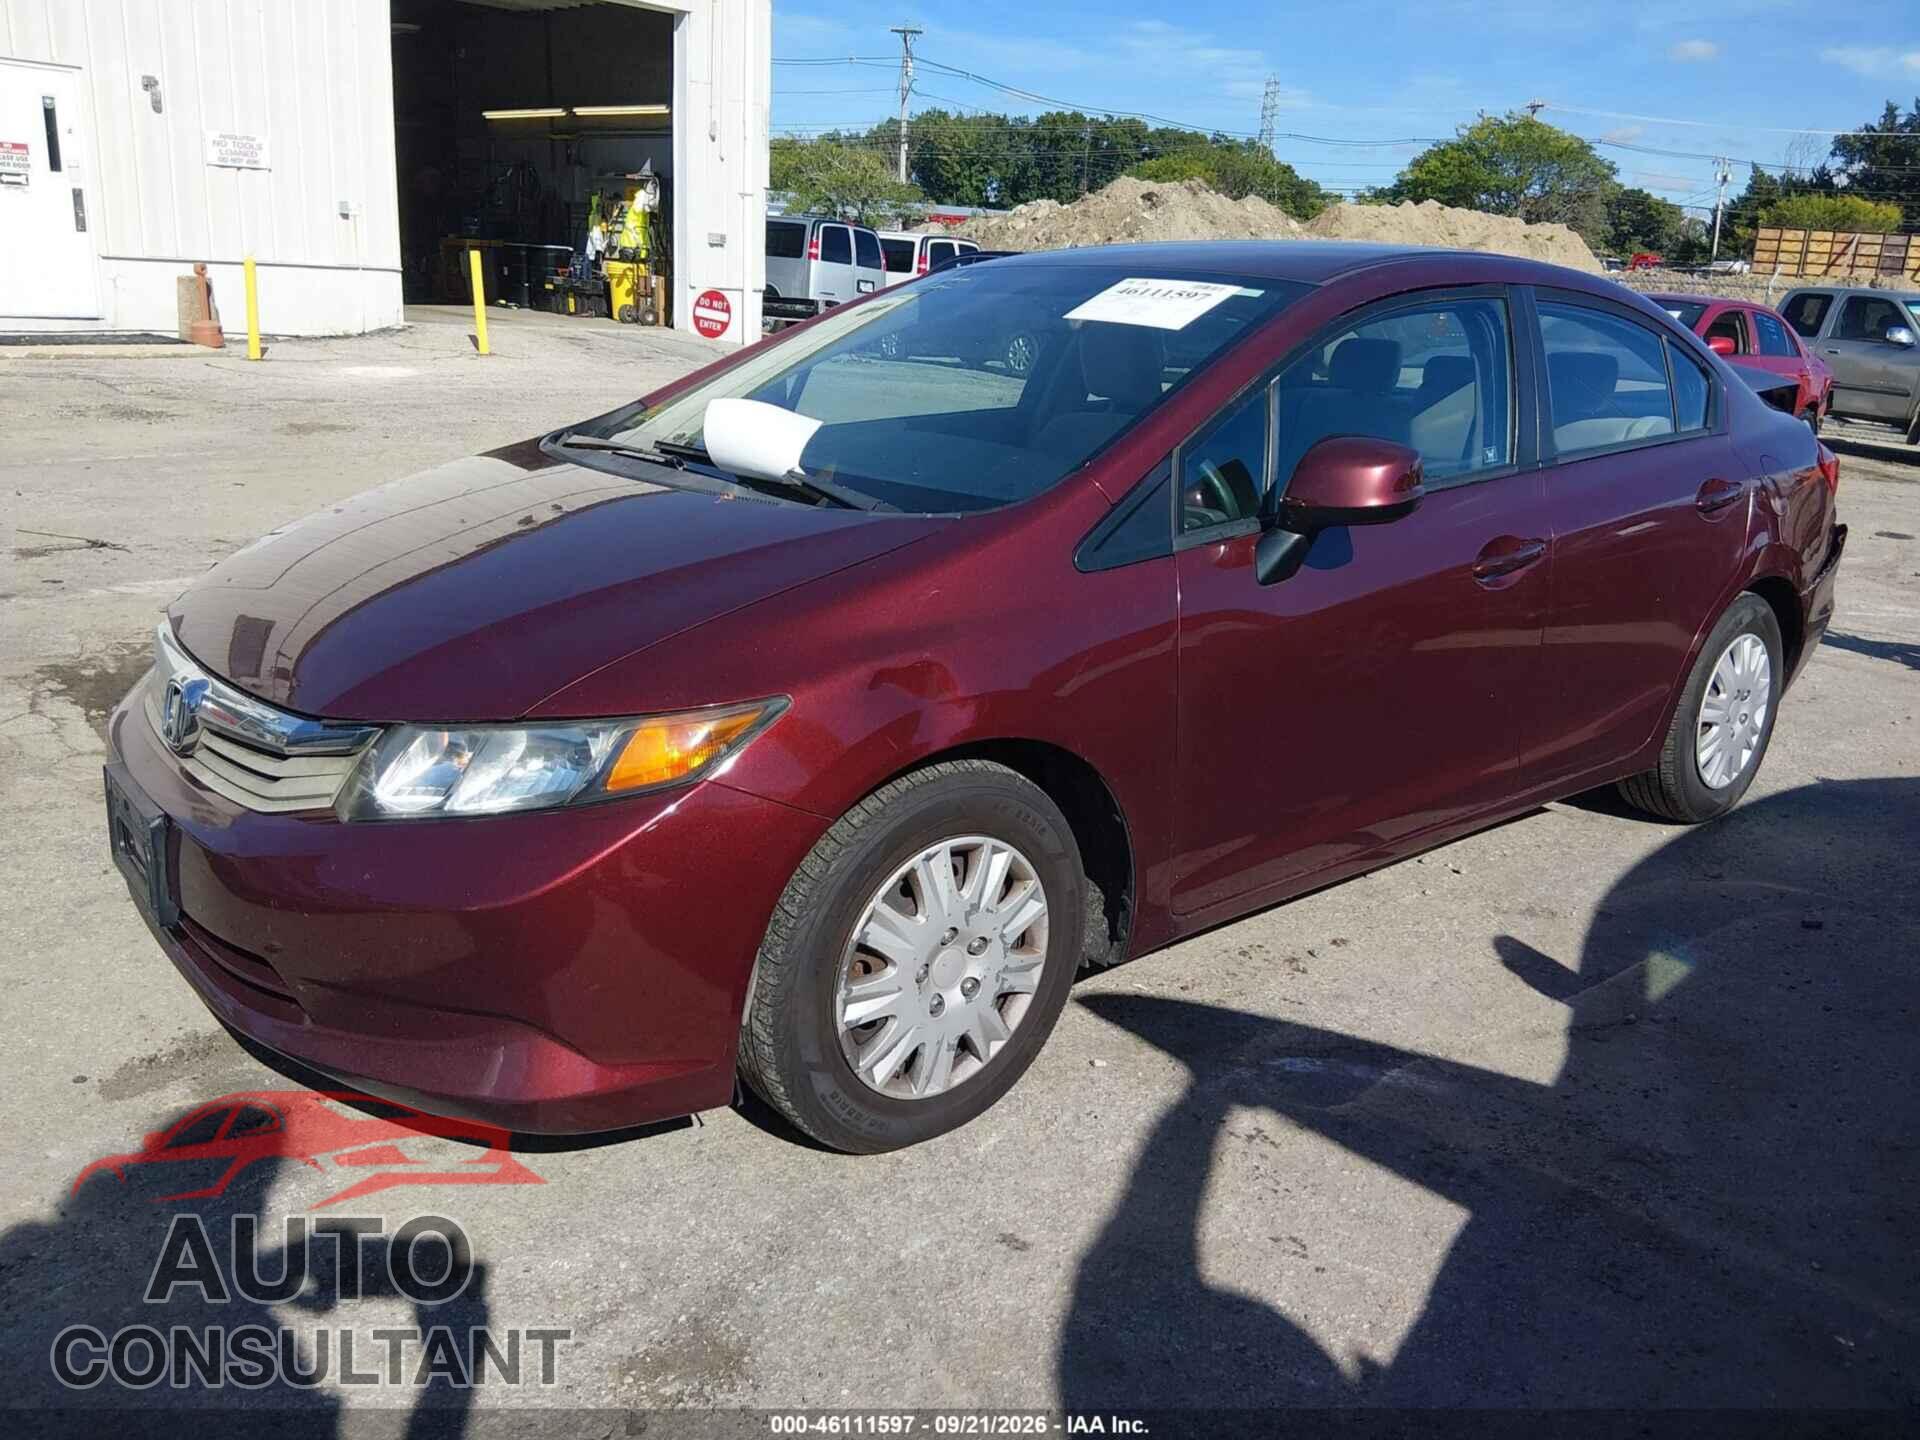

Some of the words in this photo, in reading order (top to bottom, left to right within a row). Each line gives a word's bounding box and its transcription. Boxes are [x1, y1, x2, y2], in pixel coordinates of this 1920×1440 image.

[1116, 286, 1212, 302] 46111597
[699, 297, 711, 307] DO
[712, 300, 727, 310] NOT
[699, 319, 721, 331] ENTER
